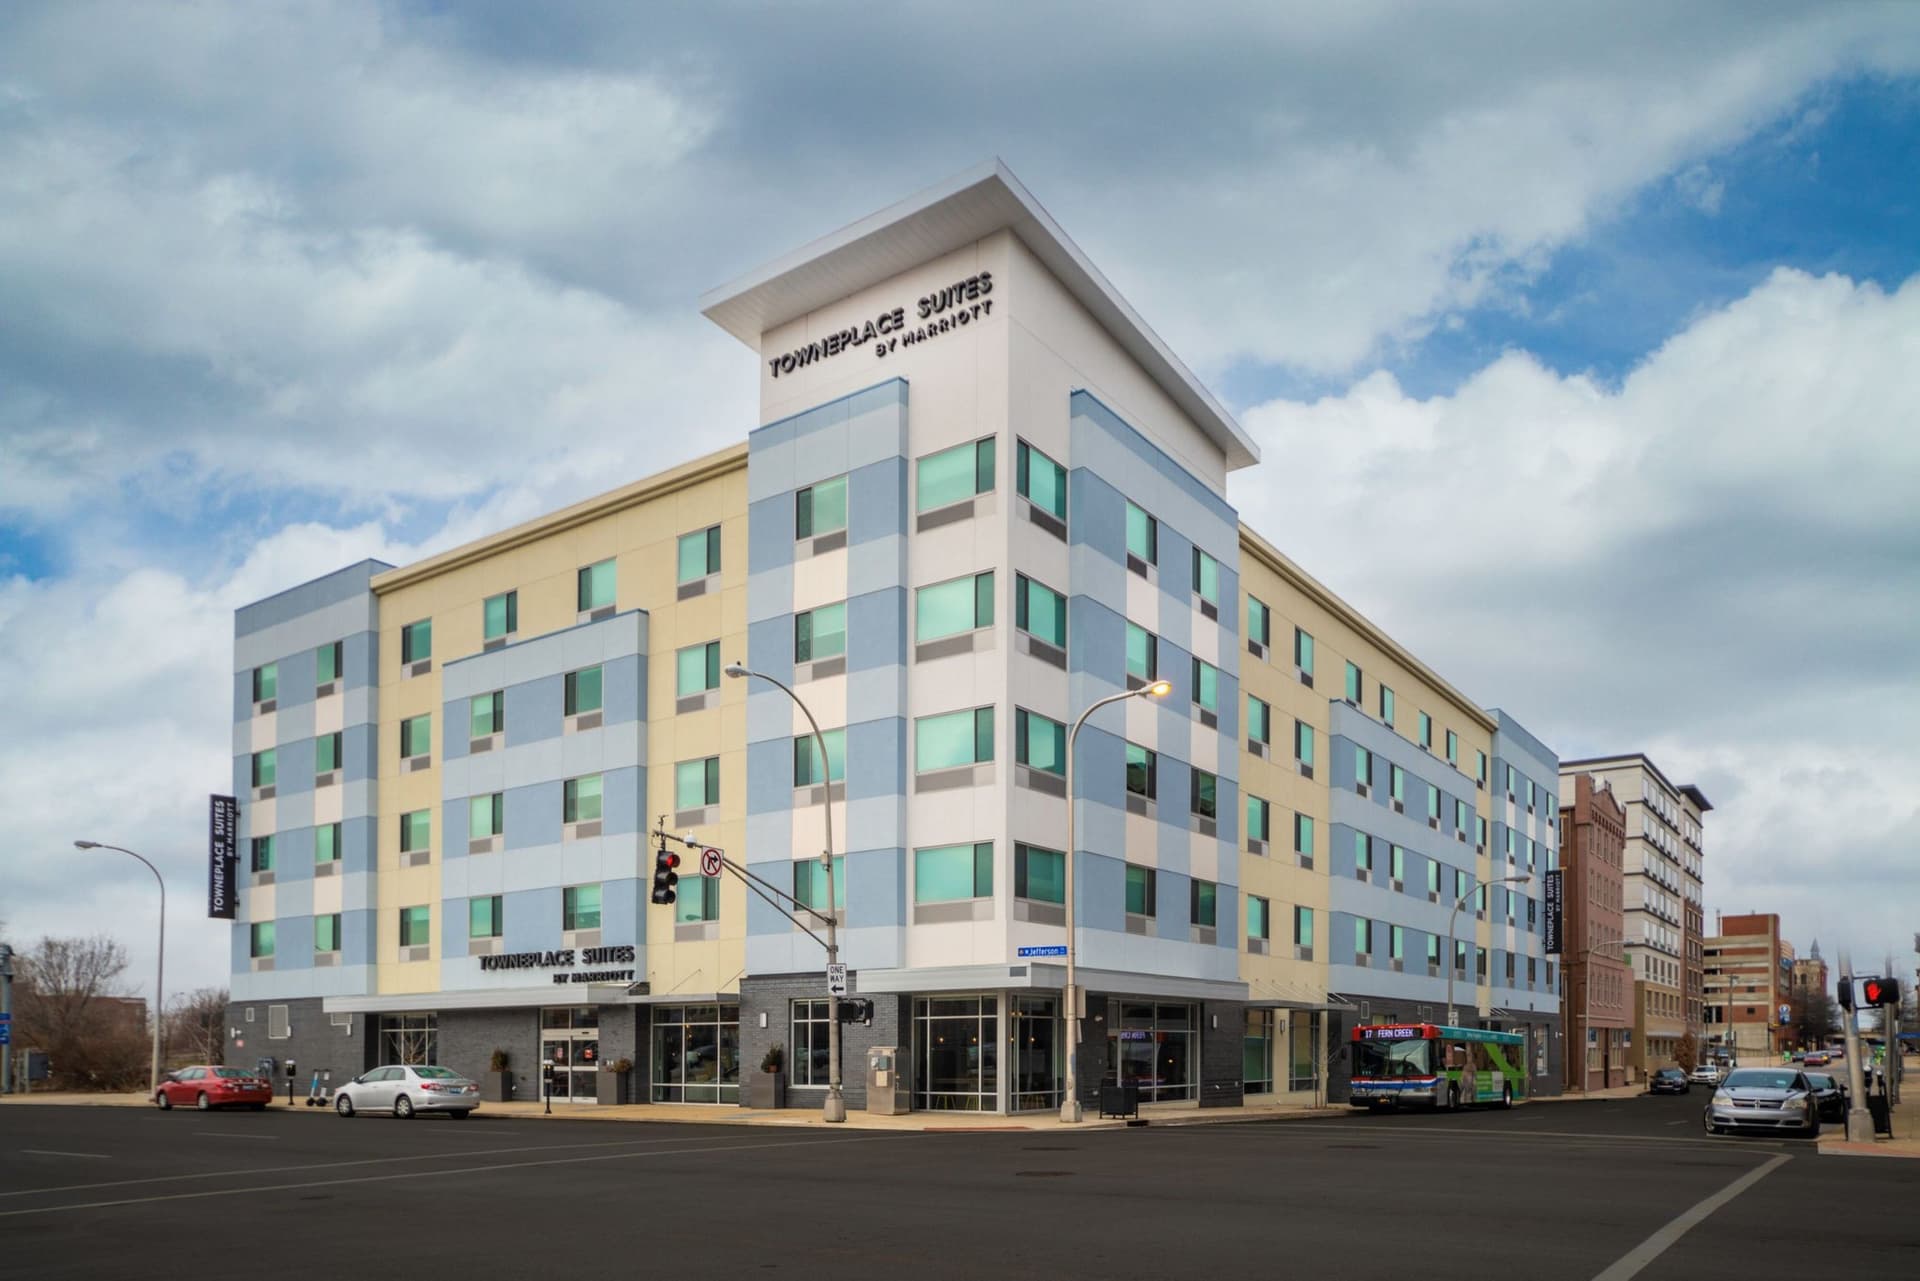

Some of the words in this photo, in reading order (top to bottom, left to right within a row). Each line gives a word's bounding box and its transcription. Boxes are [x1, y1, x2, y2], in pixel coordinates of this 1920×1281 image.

[769, 308, 904, 378] TOWNEPLACE
[917, 271, 992, 318] SUITES
[876, 338, 897, 357] BY
[902, 300, 993, 346] MARRIOTT
[215, 801, 225, 835] SUITES
[227, 845, 234, 857] BY
[214, 842, 225, 911] TOWNEPLACE
[479, 950, 574, 970] TOWNEPLACE
[582, 945, 635, 964] SUITES
[1030, 948, 1058, 956] Jefferson
[571, 970, 635, 983] MARRIOTT
[830, 966, 844, 974] ONE
[1365, 1030, 1372, 1038] 17
[1378, 1029, 1393, 1038] FERN
[1394, 1028, 1413, 1037] CREEK
